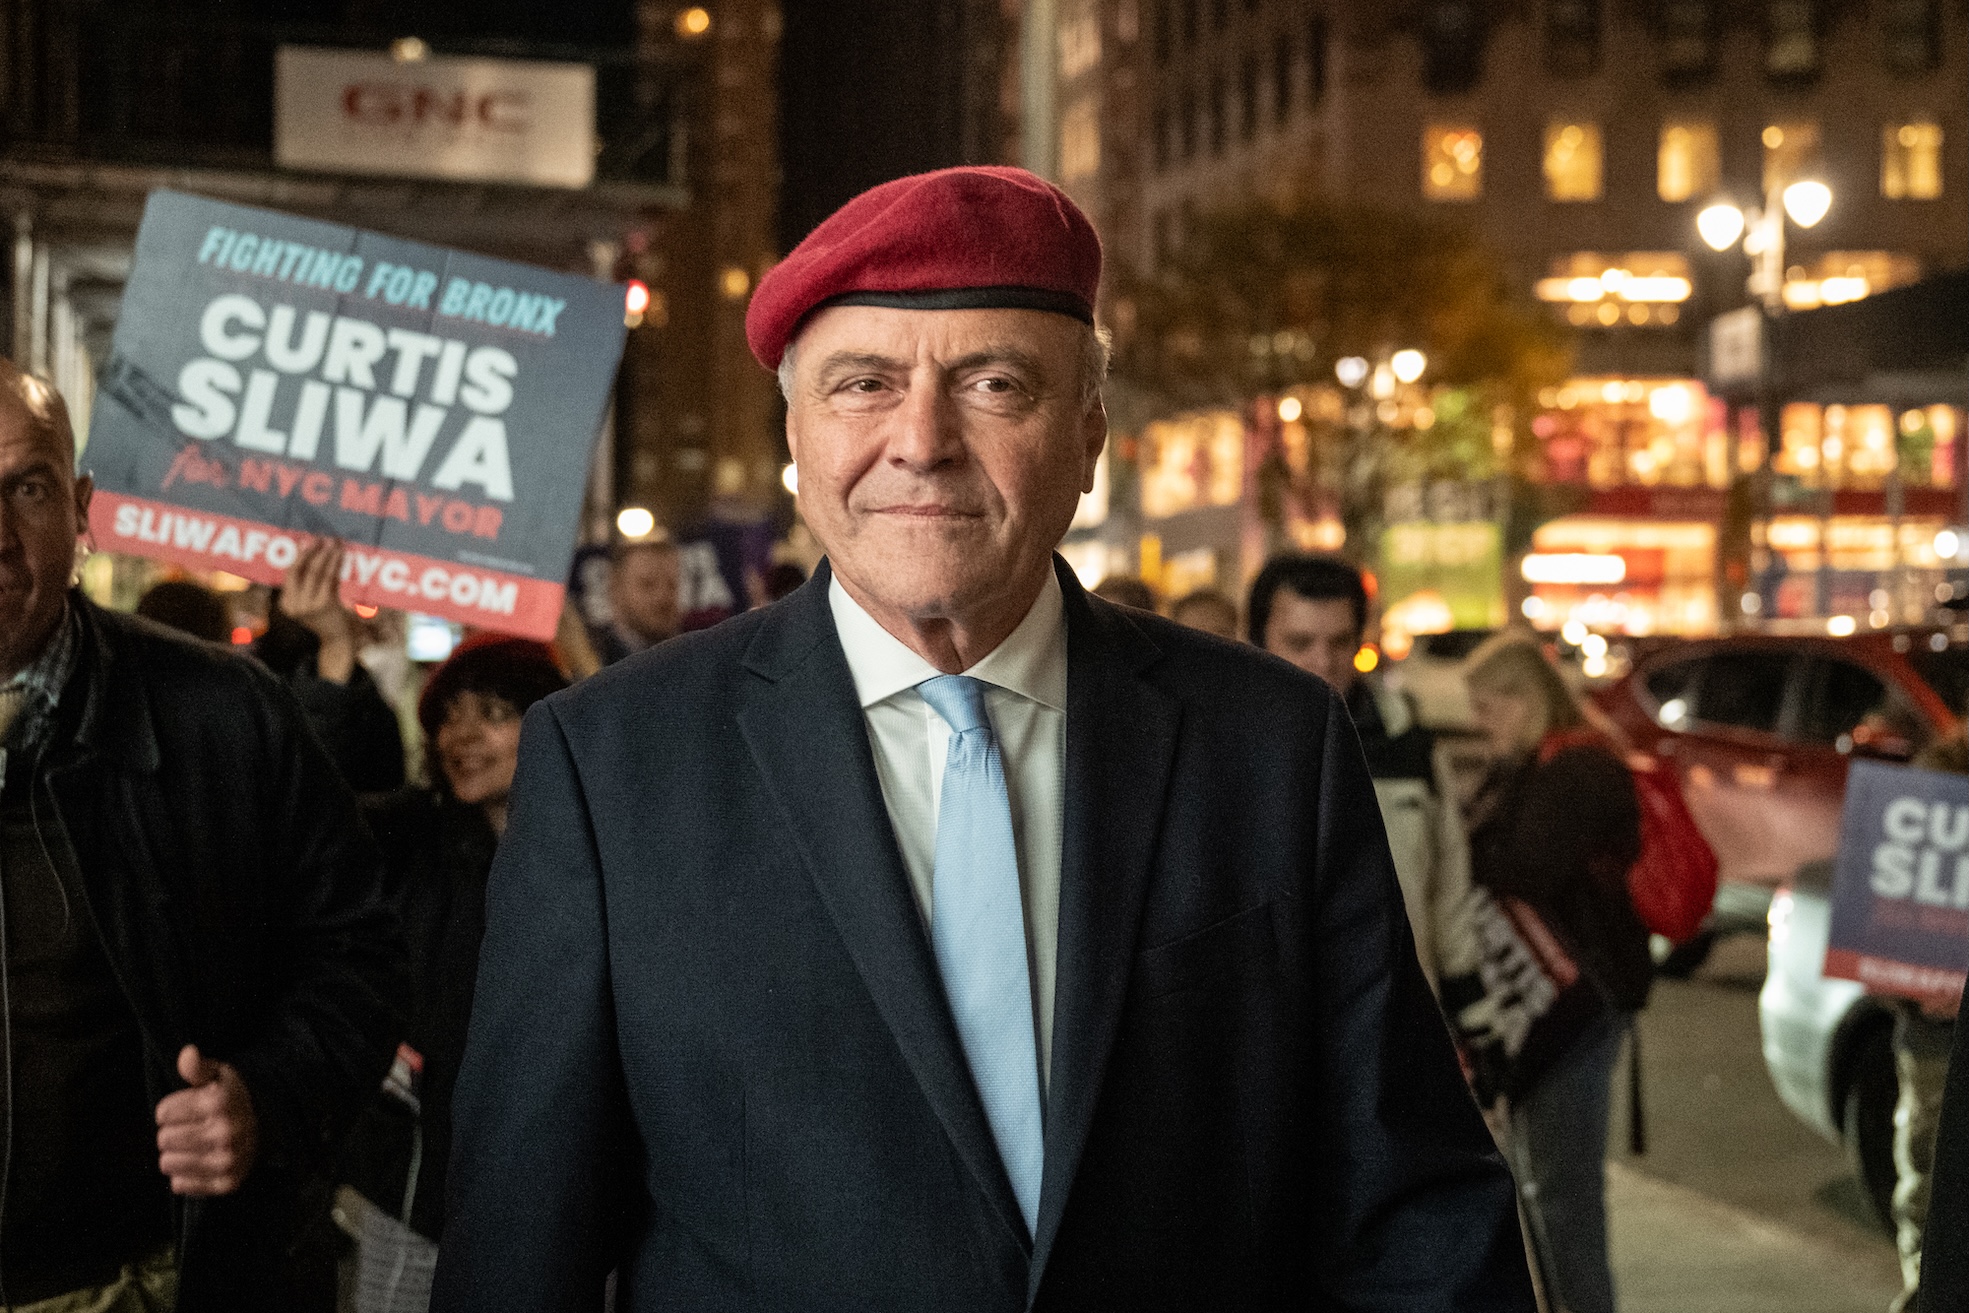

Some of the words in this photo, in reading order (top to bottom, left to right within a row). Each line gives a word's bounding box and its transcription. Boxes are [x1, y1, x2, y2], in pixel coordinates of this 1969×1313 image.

[340, 81, 533, 134] GNC
[198, 226, 364, 293] FIGHTING
[366, 261, 438, 309] FOR
[440, 278, 566, 336] BRONX
[200, 293, 518, 414] CURTIS
[174, 358, 514, 500] SLIWA
[239, 459, 334, 505] NYC
[339, 479, 504, 540] MAYOR
